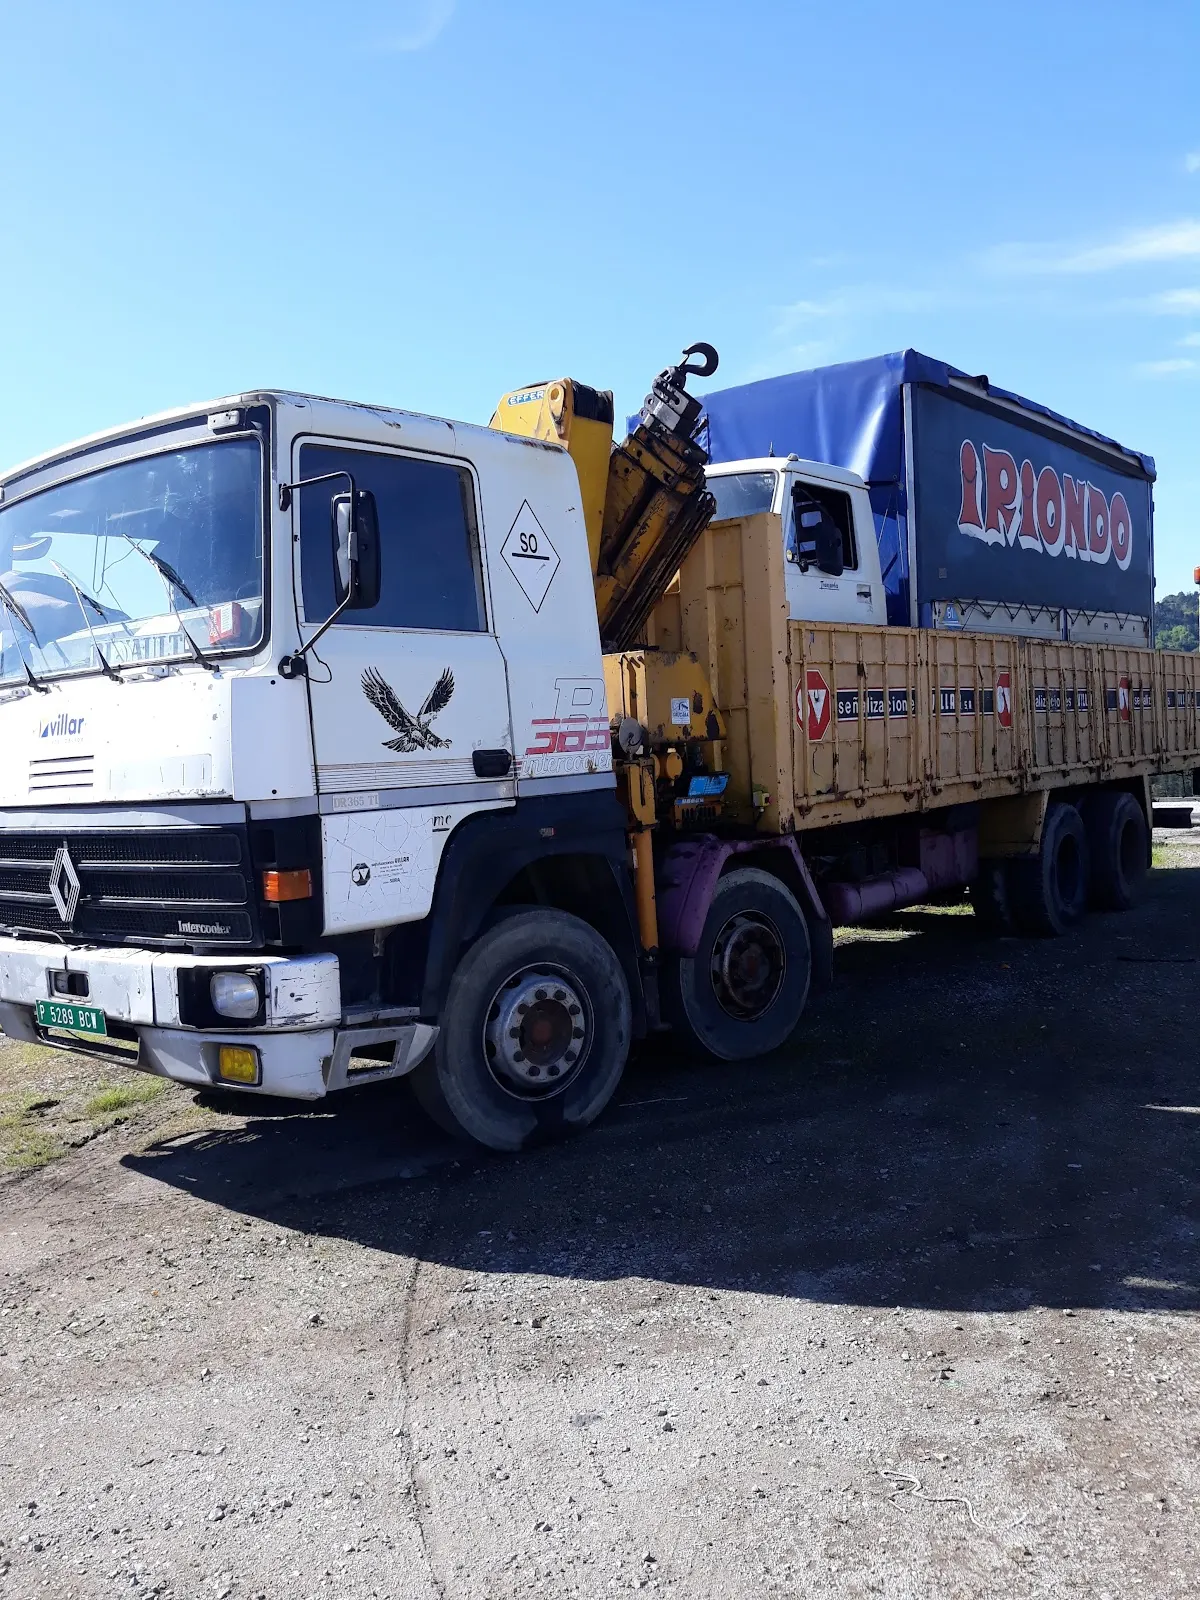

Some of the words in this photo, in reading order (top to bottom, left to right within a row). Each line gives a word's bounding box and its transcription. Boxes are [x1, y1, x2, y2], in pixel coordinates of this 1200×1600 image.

[509, 390, 544, 405] EFFER
[957, 438, 1132, 571] IRIONDO
[838, 696, 915, 715] señlizacione
[50, 713, 85, 737] villar
[525, 717, 611, 755] 365
[177, 920, 231, 935] Intercooler
[39, 1004, 45, 1020] P
[50, 1006, 74, 1025] 5289
[78, 1010, 97, 1029] BCW
